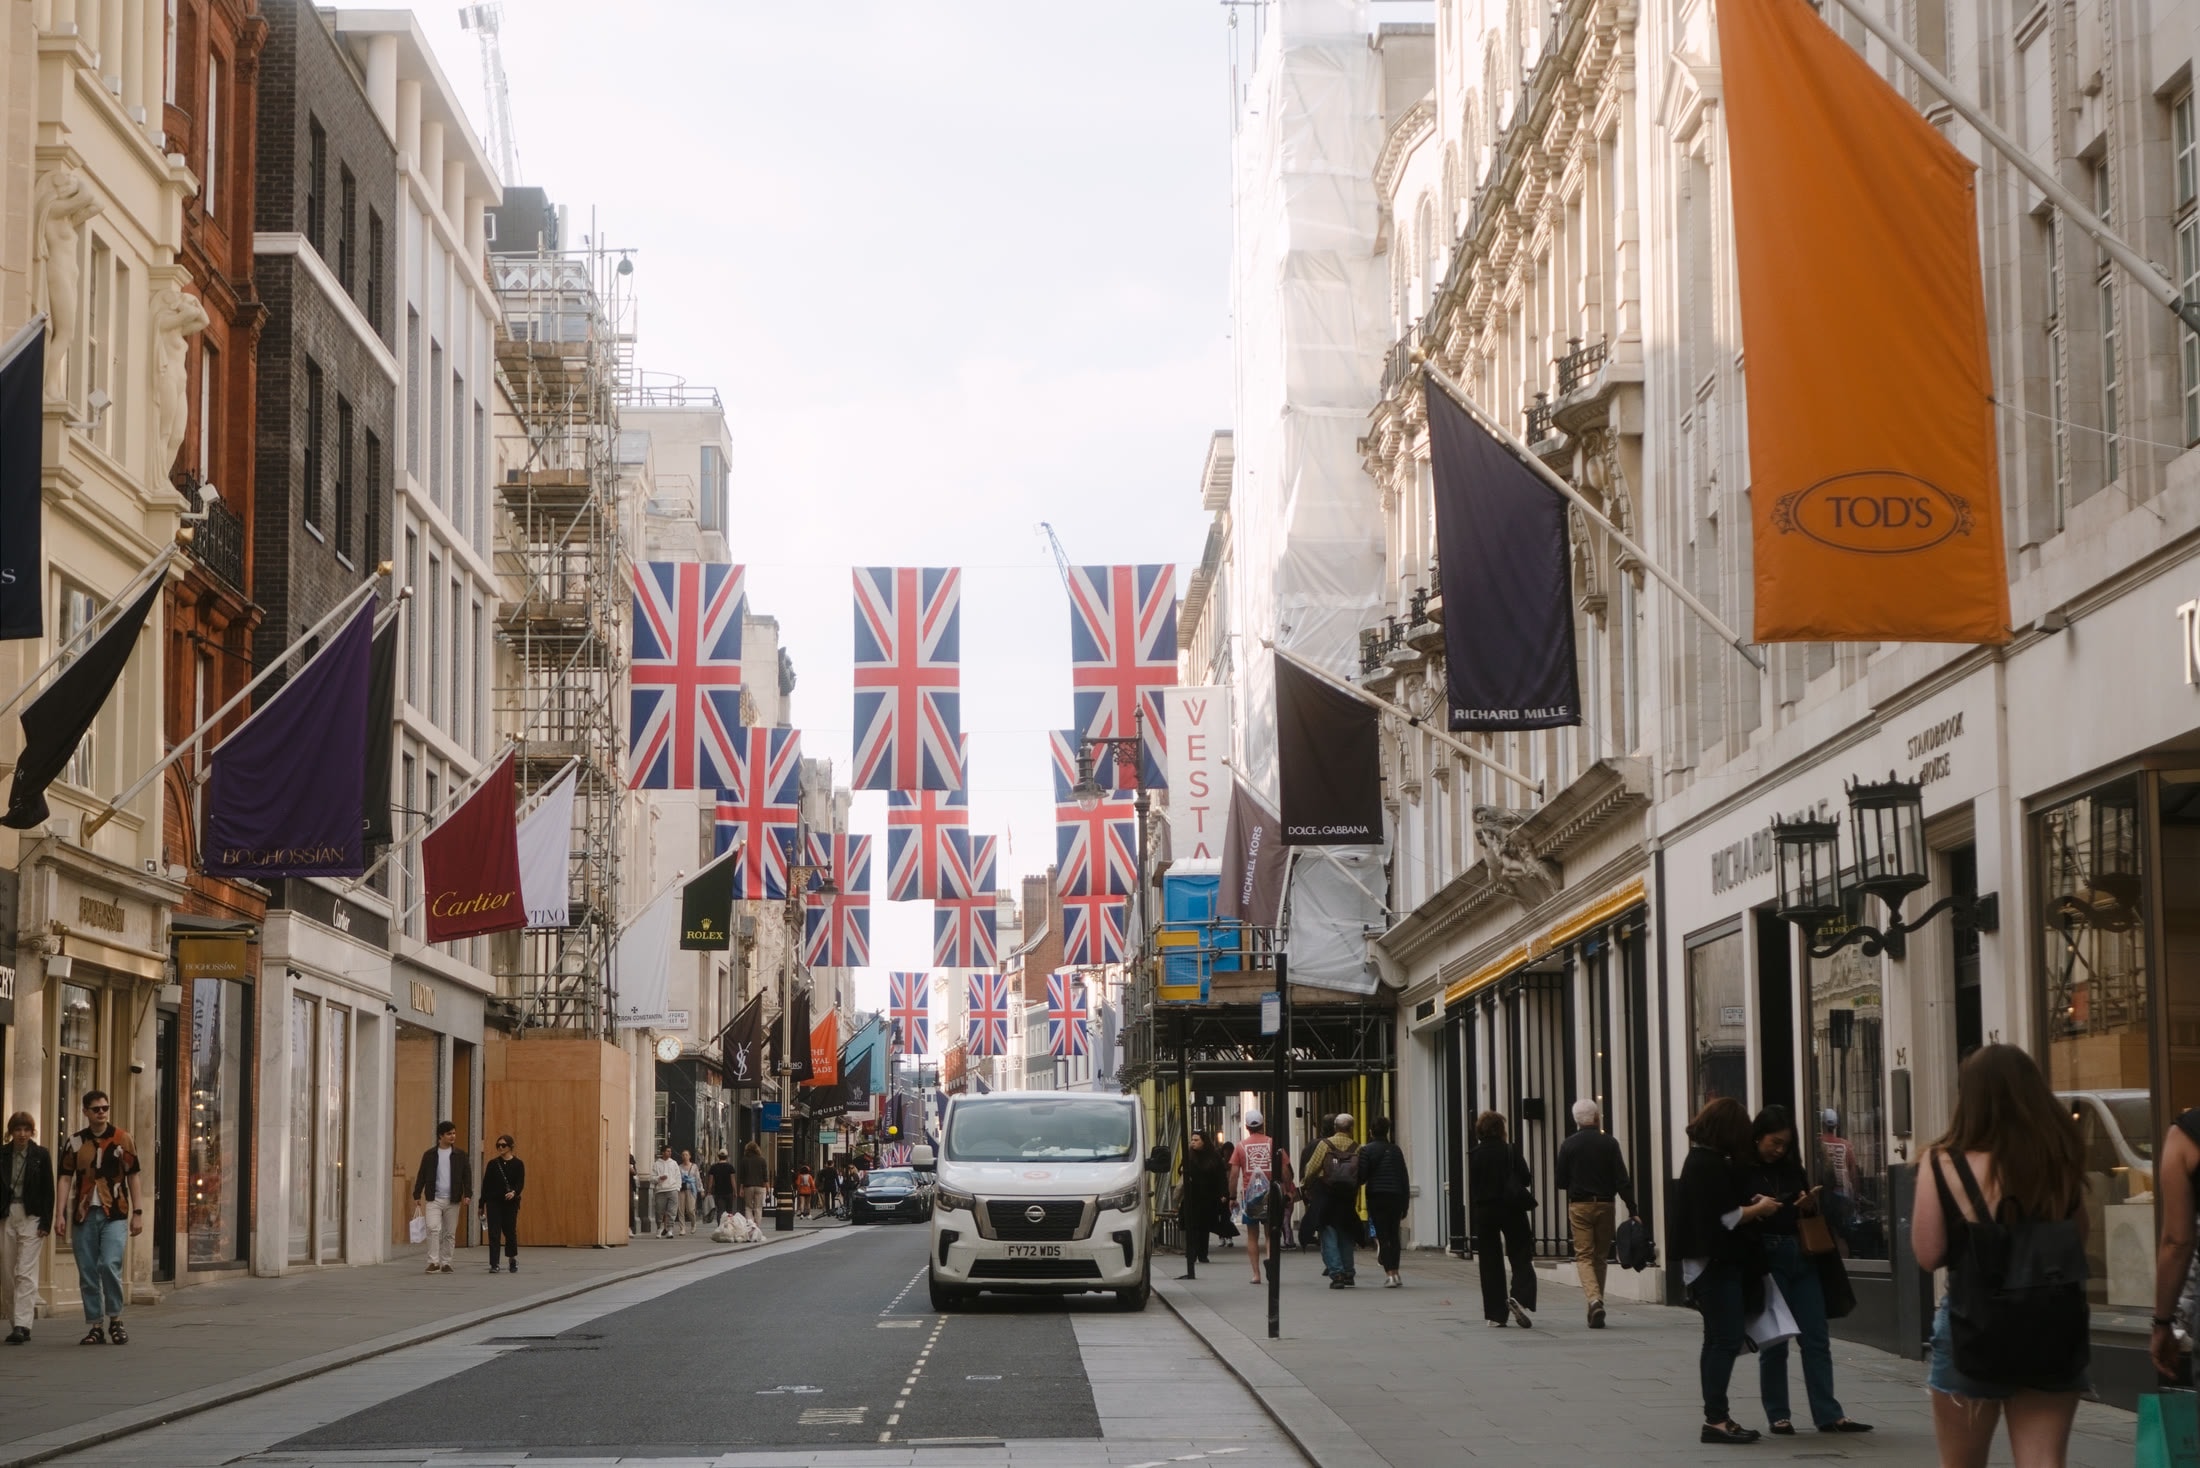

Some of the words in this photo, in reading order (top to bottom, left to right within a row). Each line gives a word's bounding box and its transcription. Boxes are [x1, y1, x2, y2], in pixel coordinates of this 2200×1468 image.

[1825, 495, 1933, 529] TOD'S
[1454, 708, 1520, 721] RICHARD
[1524, 705, 1569, 719] MILLE
[1907, 711, 1965, 761] STANDBROOK
[1921, 752, 1951, 786] HOUSE
[1288, 826, 1317, 835] DOLCE
[1322, 825, 1369, 836] GABBANA
[1242, 857, 1258, 906] MICHAEL
[1250, 825, 1264, 857] KORS
[1711, 826, 1773, 896] RICHARD
[332, 898, 351, 932] Cartier
[431, 890, 516, 918] Cartier
[686, 930, 724, 940] ROLEX
[1008, 1245, 1037, 1257] FY72
[1039, 1245, 1061, 1257] WDS
